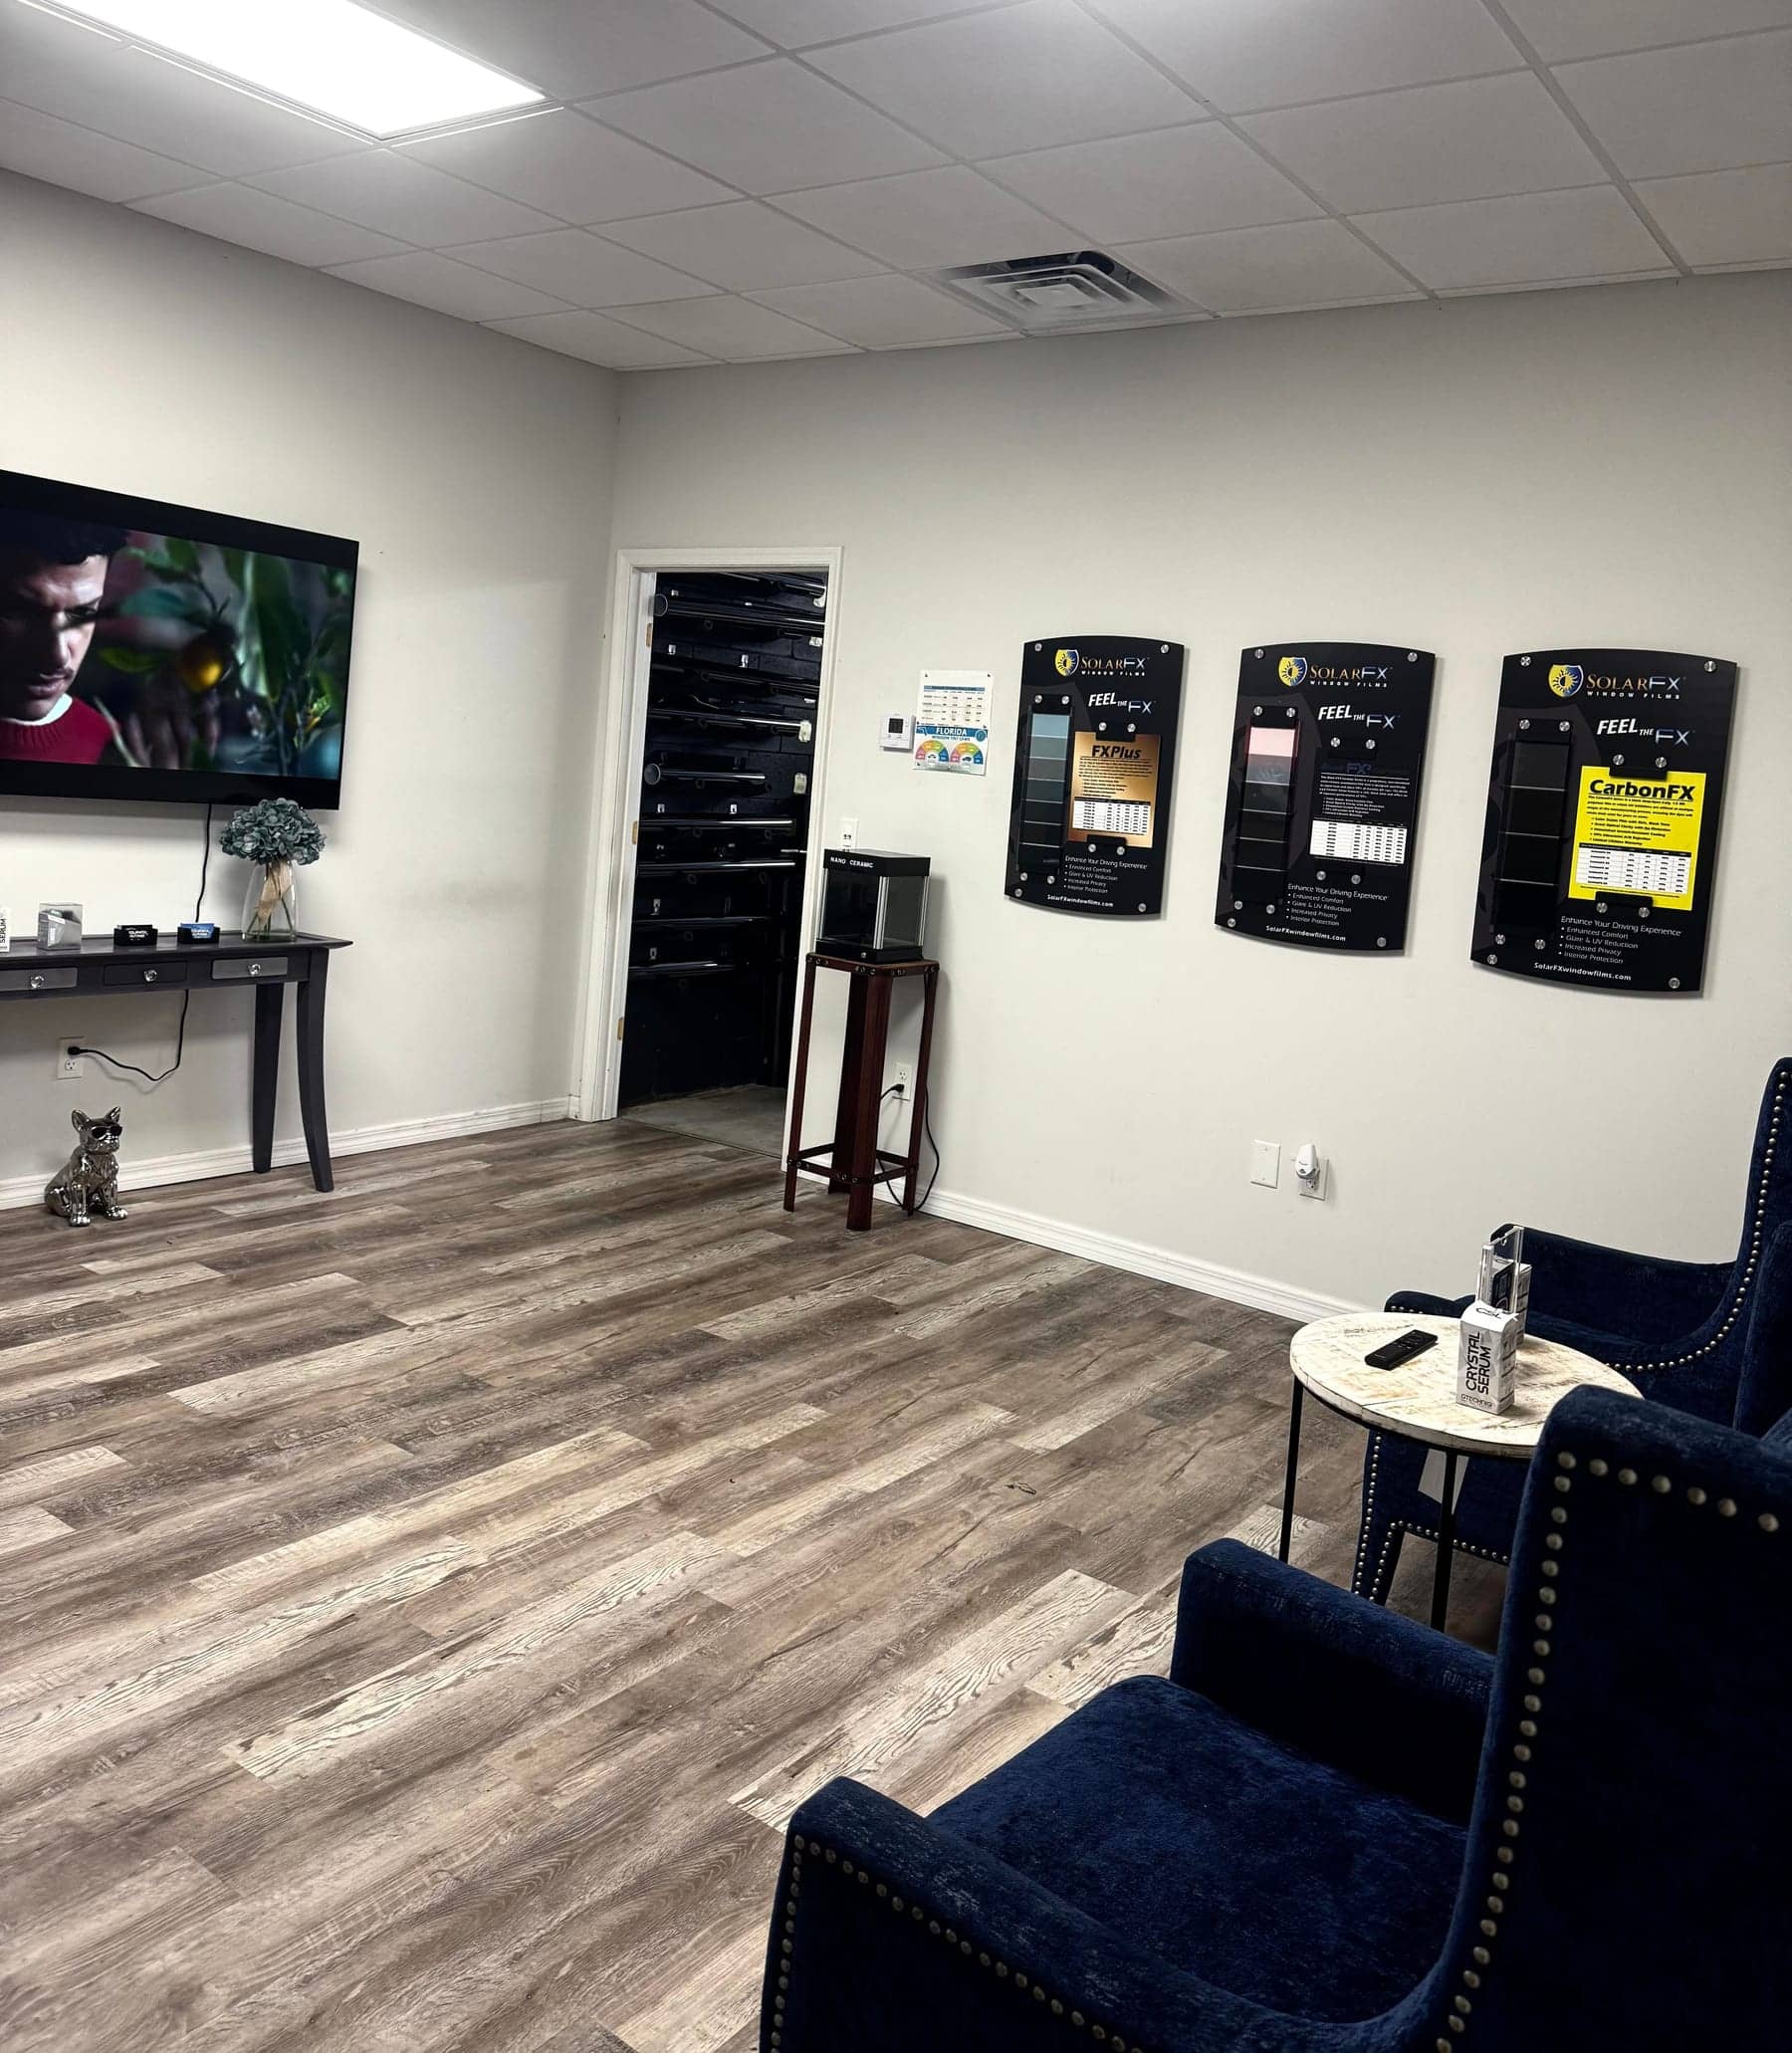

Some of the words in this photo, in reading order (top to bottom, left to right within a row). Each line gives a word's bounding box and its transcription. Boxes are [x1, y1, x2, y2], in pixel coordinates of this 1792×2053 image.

[1088, 692, 1116, 707] FEEL
[1128, 701, 1152, 714] FX
[1317, 705, 1352, 720] FEEL
[1366, 714, 1395, 729] FX
[936, 727, 968, 736] FLORIDA
[1597, 718, 1638, 735] FEEL
[1656, 729, 1689, 746] FX
[1092, 745, 1142, 759] FXPlus
[1590, 780, 1695, 799] CarbonFX
[849, 859, 874, 868] CERAMIC
[1287, 883, 1314, 892] Enhance
[1330, 888, 1352, 898] Driving
[1561, 916, 1593, 926] Enhance
[1613, 921, 1639, 933] Driving
[1641, 925, 1681, 936] Experience
[1566, 926, 1600, 936] Enhanced
[1601, 930, 1629, 940] Comfort
[1565, 943, 1596, 952] Increased
[1597, 947, 1622, 956] Privacy
[1604, 940, 1639, 949] Reduction
[1590, 954, 1623, 964] Protection
[1534, 962, 1632, 981] SolarFXwindowfilms.com
[1465, 1330, 1480, 1391] CRYSTAL
[1477, 1345, 1491, 1395] SERUM
